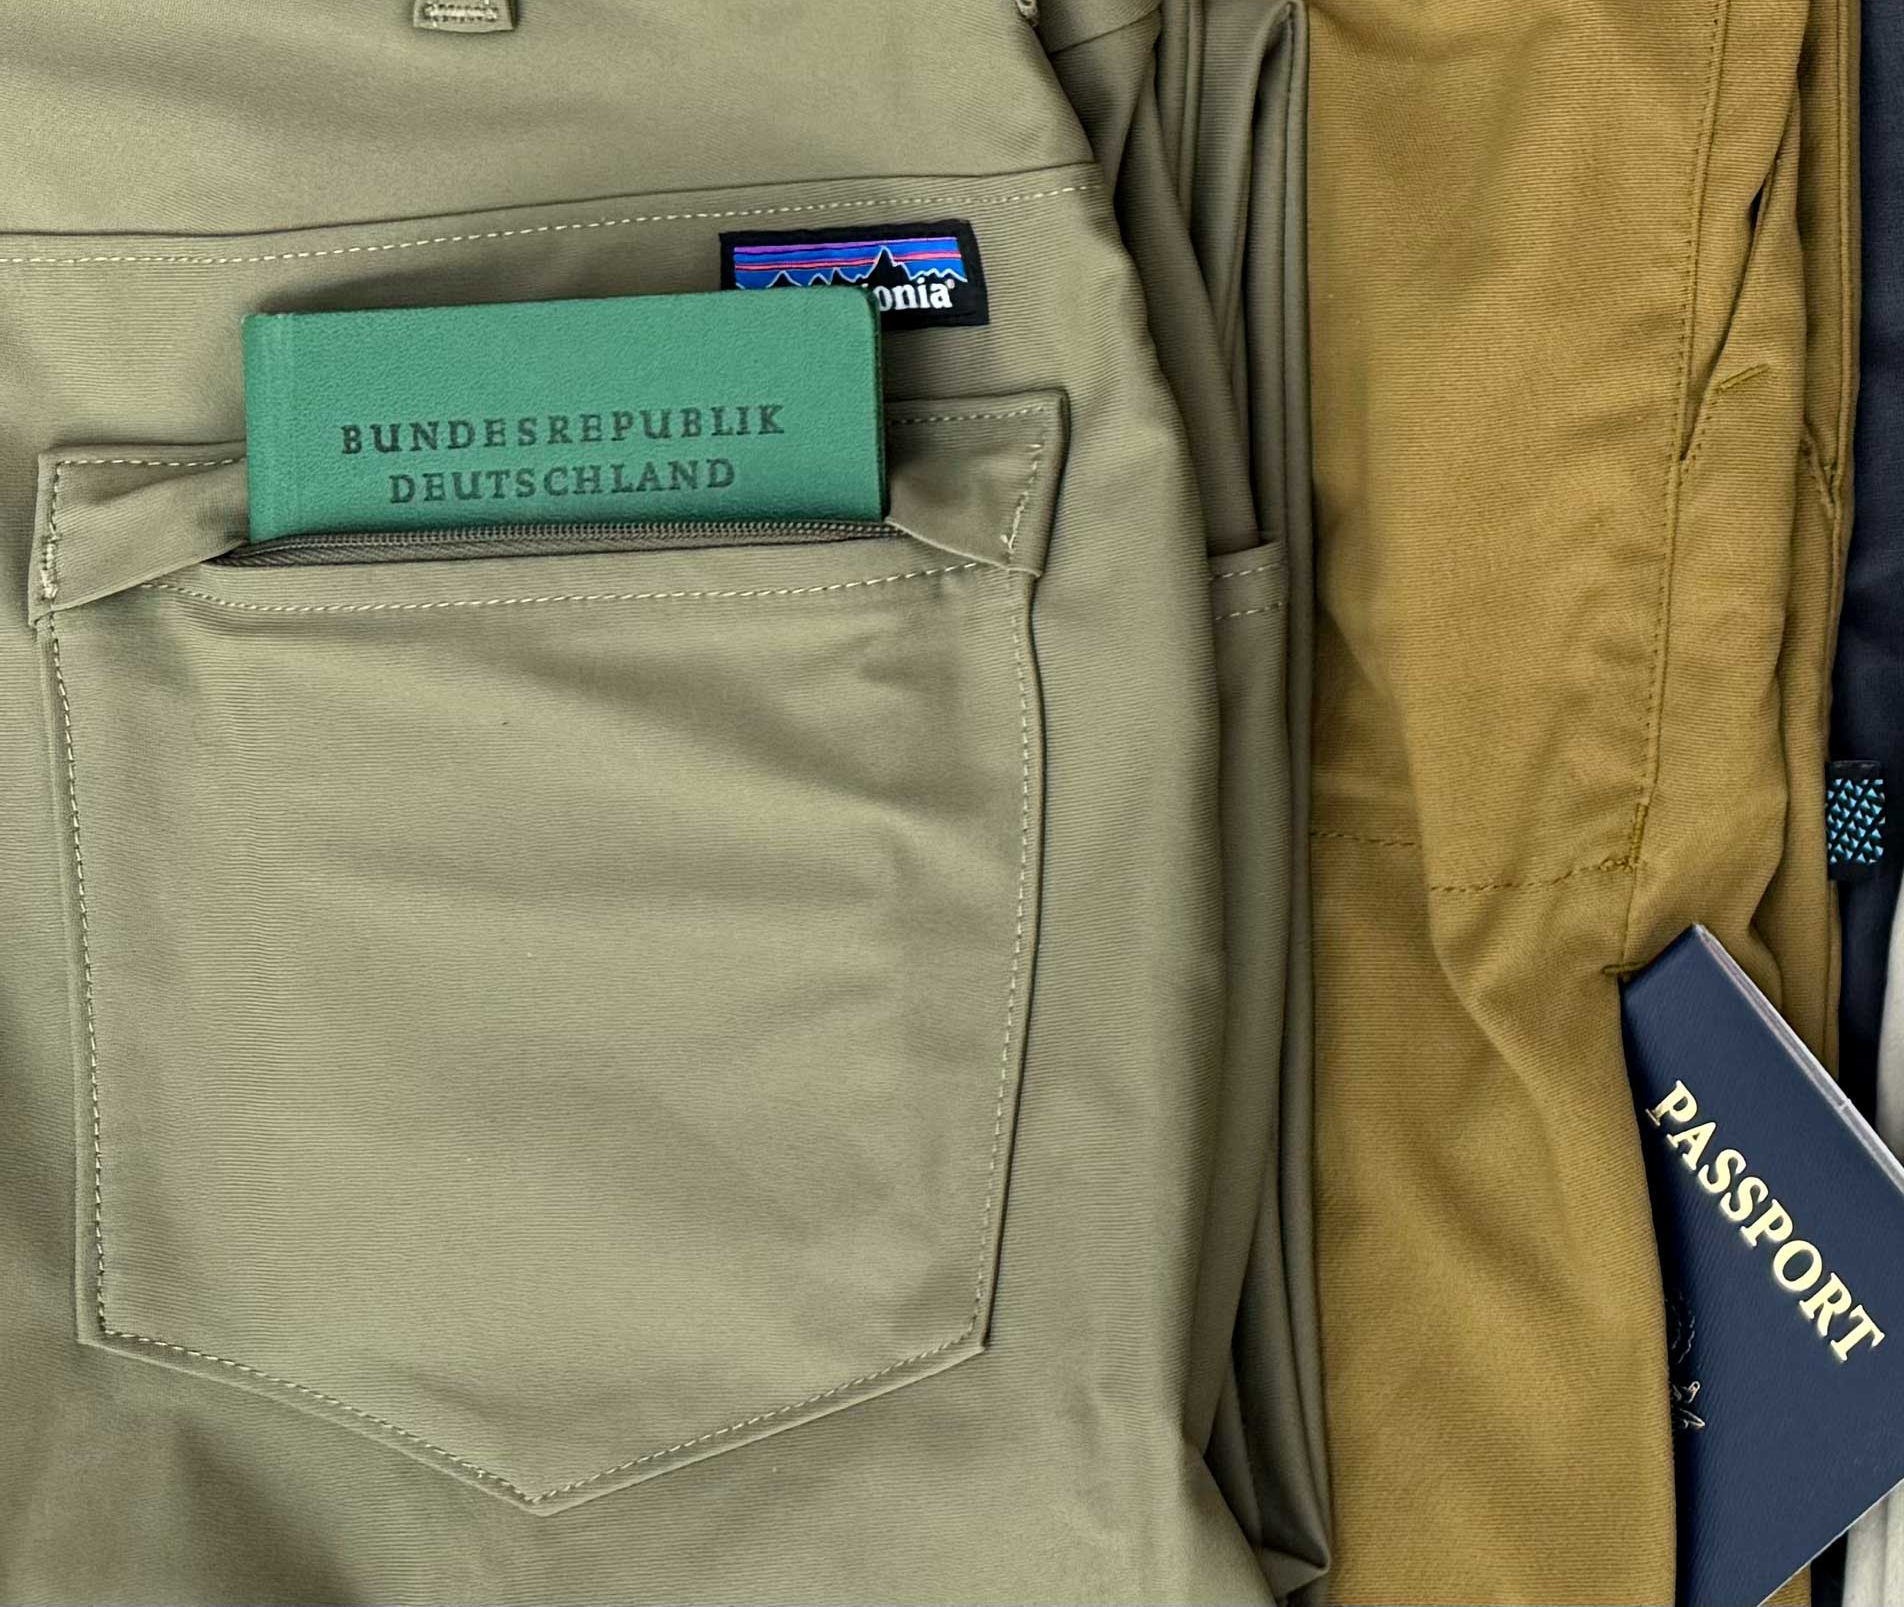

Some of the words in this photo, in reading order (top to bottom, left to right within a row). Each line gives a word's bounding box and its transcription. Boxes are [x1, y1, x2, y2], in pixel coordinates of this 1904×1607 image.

[340, 403, 786, 456] BUNDESREPUBLIK
[389, 455, 737, 505] DEUTSCHLAND
[1644, 1080, 1887, 1363] PASSPORT
